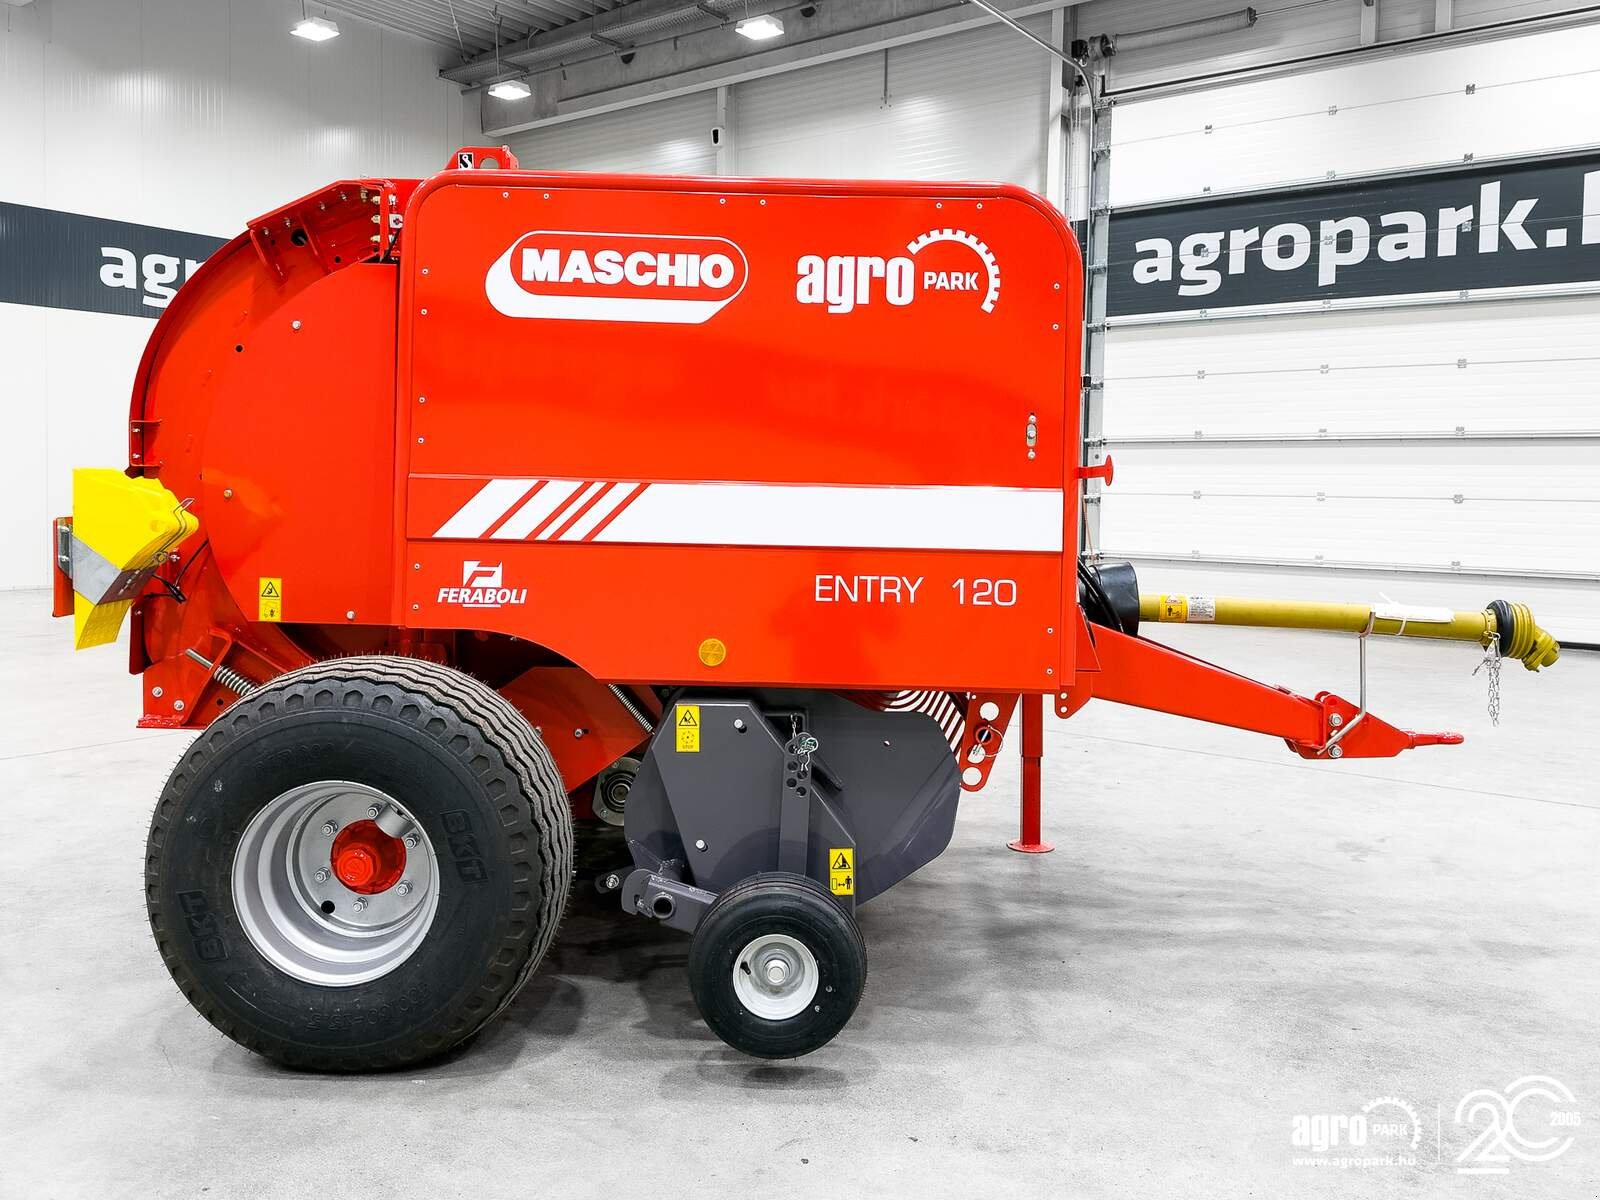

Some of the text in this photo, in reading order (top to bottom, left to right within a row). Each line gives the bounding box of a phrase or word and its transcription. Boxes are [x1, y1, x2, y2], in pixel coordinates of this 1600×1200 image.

[521, 247, 735, 289] MASCHIO
[796, 255, 979, 314] agro PARK
[437, 587, 528, 604] FERABOLI
[815, 574, 1017, 607] ENTRY 120
[440, 808, 488, 884] BKT
[178, 890, 230, 961] BKT
